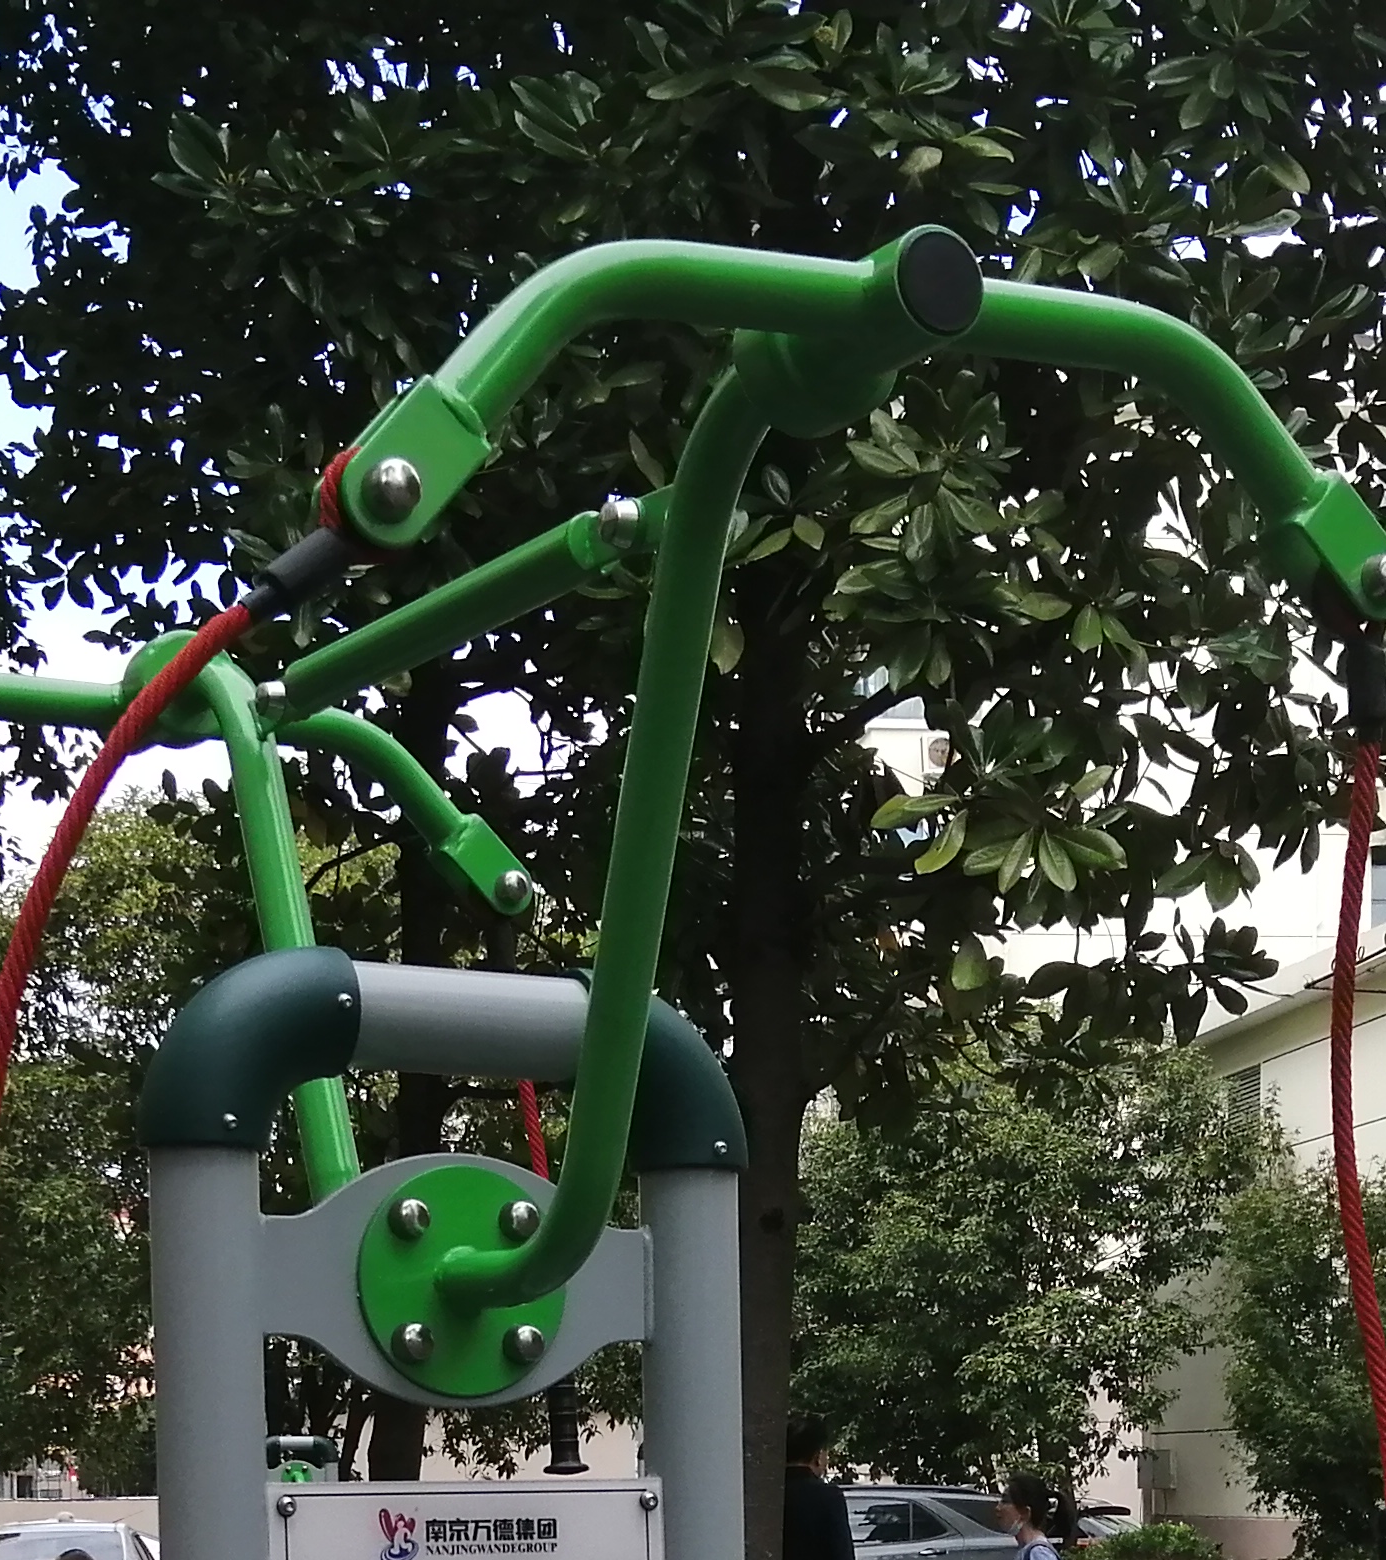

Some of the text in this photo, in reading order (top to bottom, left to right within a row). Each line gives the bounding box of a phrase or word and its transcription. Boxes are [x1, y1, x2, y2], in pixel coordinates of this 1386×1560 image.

[425, 1518, 557, 1543] 南京万德集团
[426, 1543, 558, 1556] NANJINGWANDEGROUP
